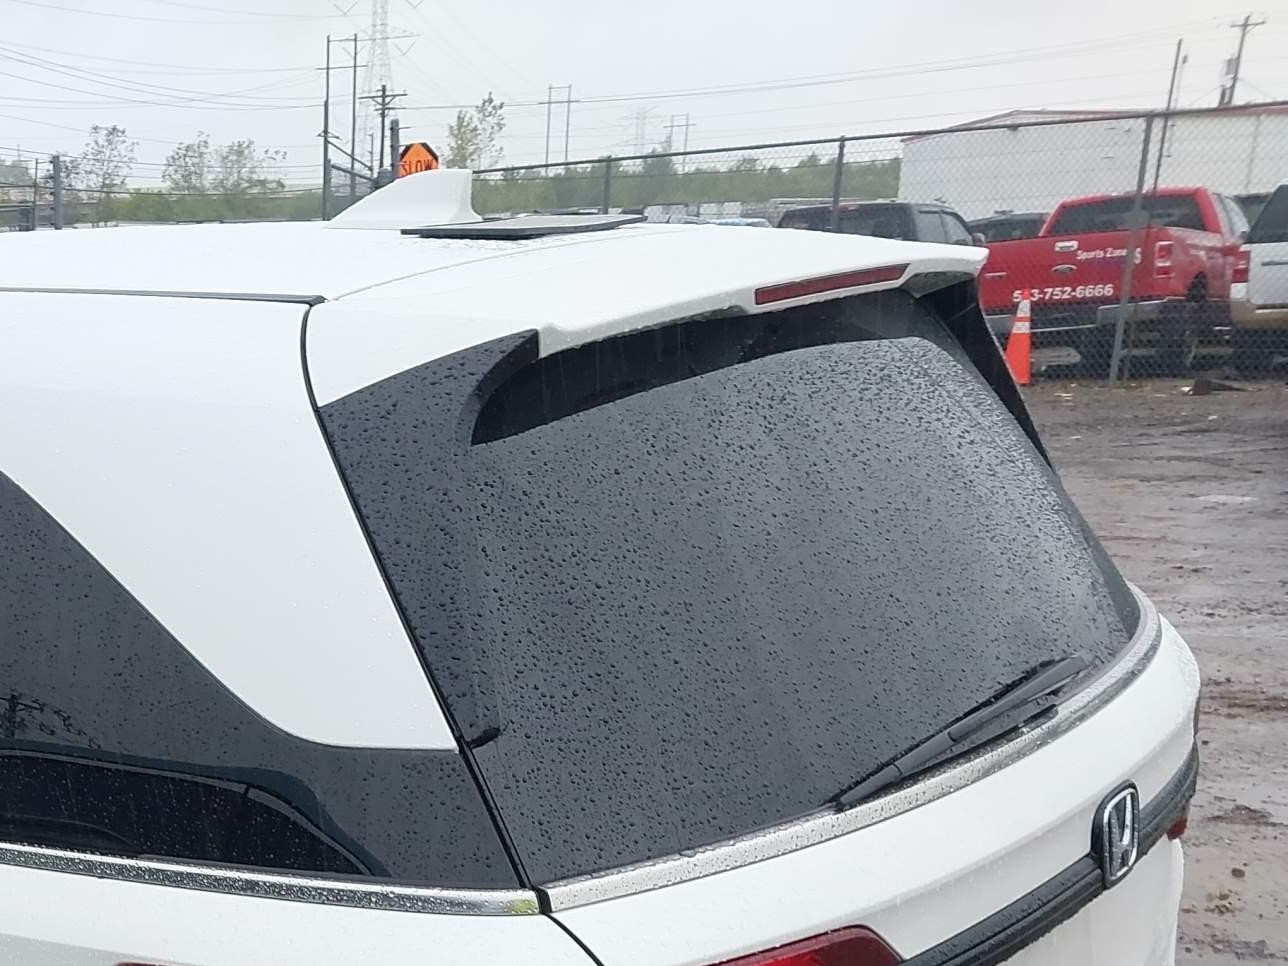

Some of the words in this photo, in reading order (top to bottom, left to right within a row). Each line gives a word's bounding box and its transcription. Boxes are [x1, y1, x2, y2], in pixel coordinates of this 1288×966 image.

[400, 158, 434, 176] SLOW
[1075, 249, 1105, 261] Sports
[1012, 284, 1114, 302] 53-752-6666
